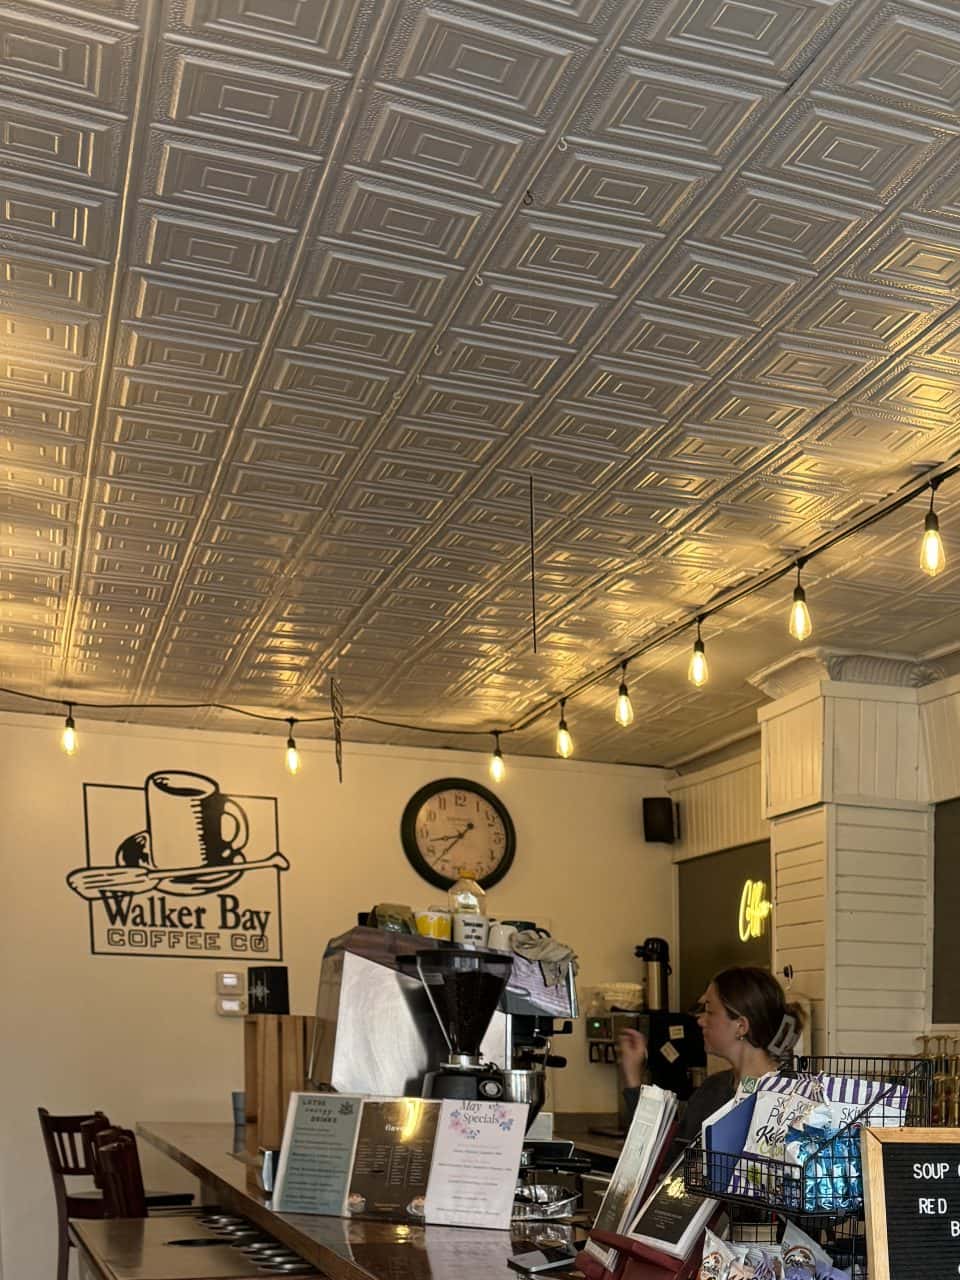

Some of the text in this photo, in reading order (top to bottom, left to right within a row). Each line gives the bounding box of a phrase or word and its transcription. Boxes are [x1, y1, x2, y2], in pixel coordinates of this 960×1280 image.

[454, 793, 467, 807] 12
[99, 889, 271, 943] Walker Bay
[107, 928, 269, 952] COFFEE CO
[462, 1101, 482, 1113] May
[463, 1113, 499, 1124] Specials
[913, 1163, 950, 1179] SOUP
[918, 1198, 948, 1214] RED
